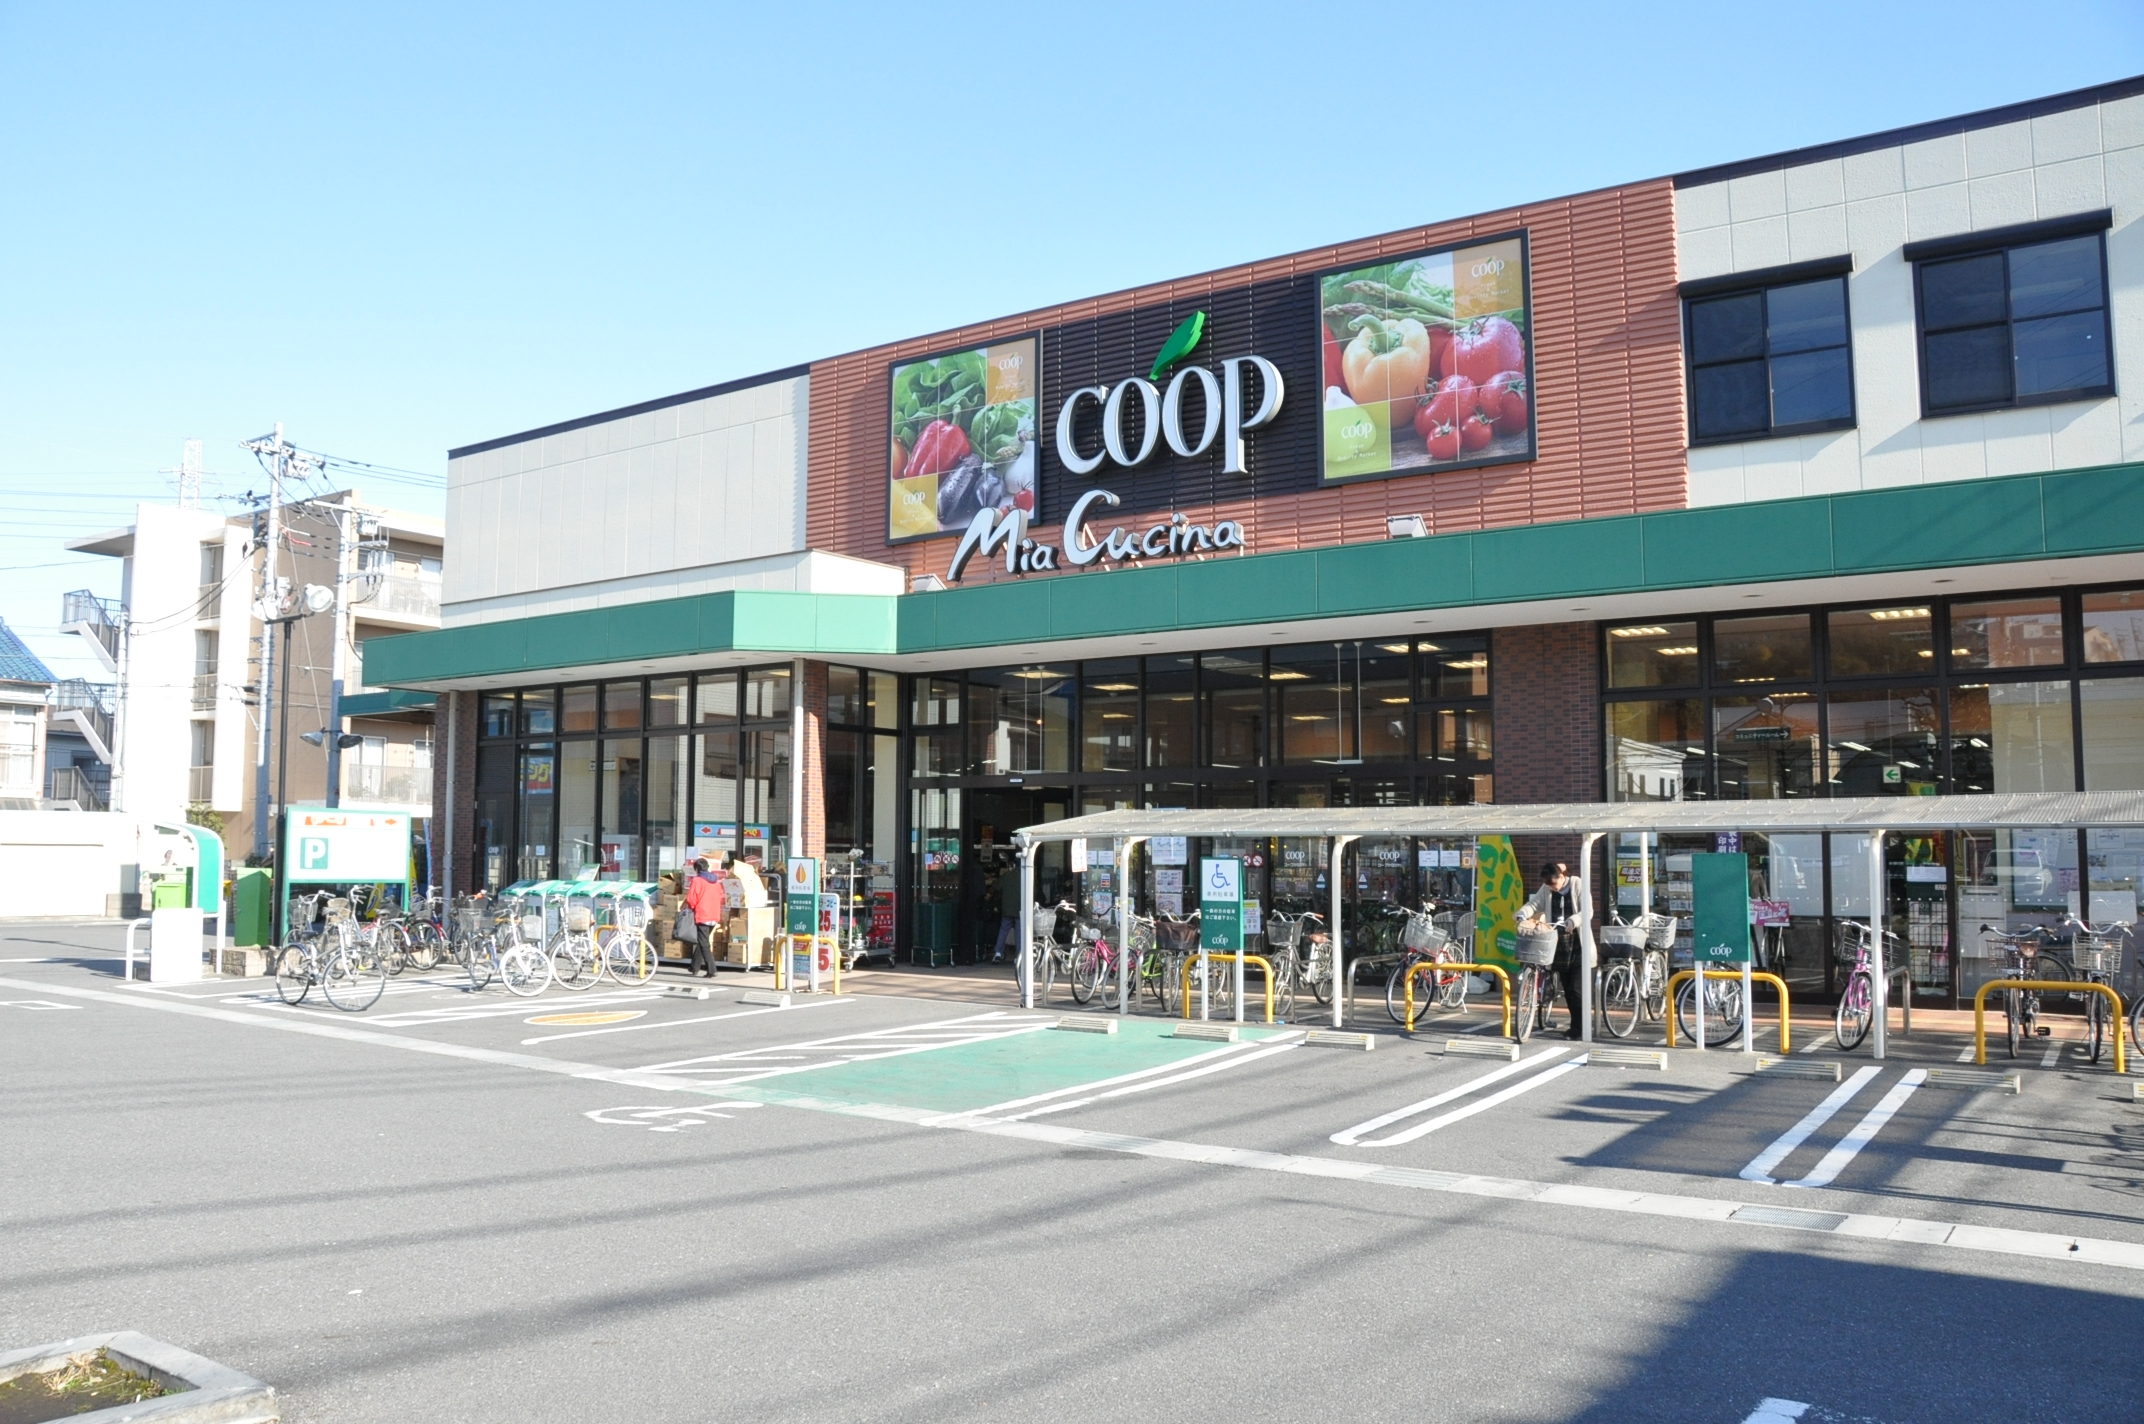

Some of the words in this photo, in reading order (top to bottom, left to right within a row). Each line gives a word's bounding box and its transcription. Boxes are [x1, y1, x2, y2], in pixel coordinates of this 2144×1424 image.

[947, 507, 1060, 581] Mia
[1063, 489, 1247, 567] Cucina
[304, 838, 327, 868] P
